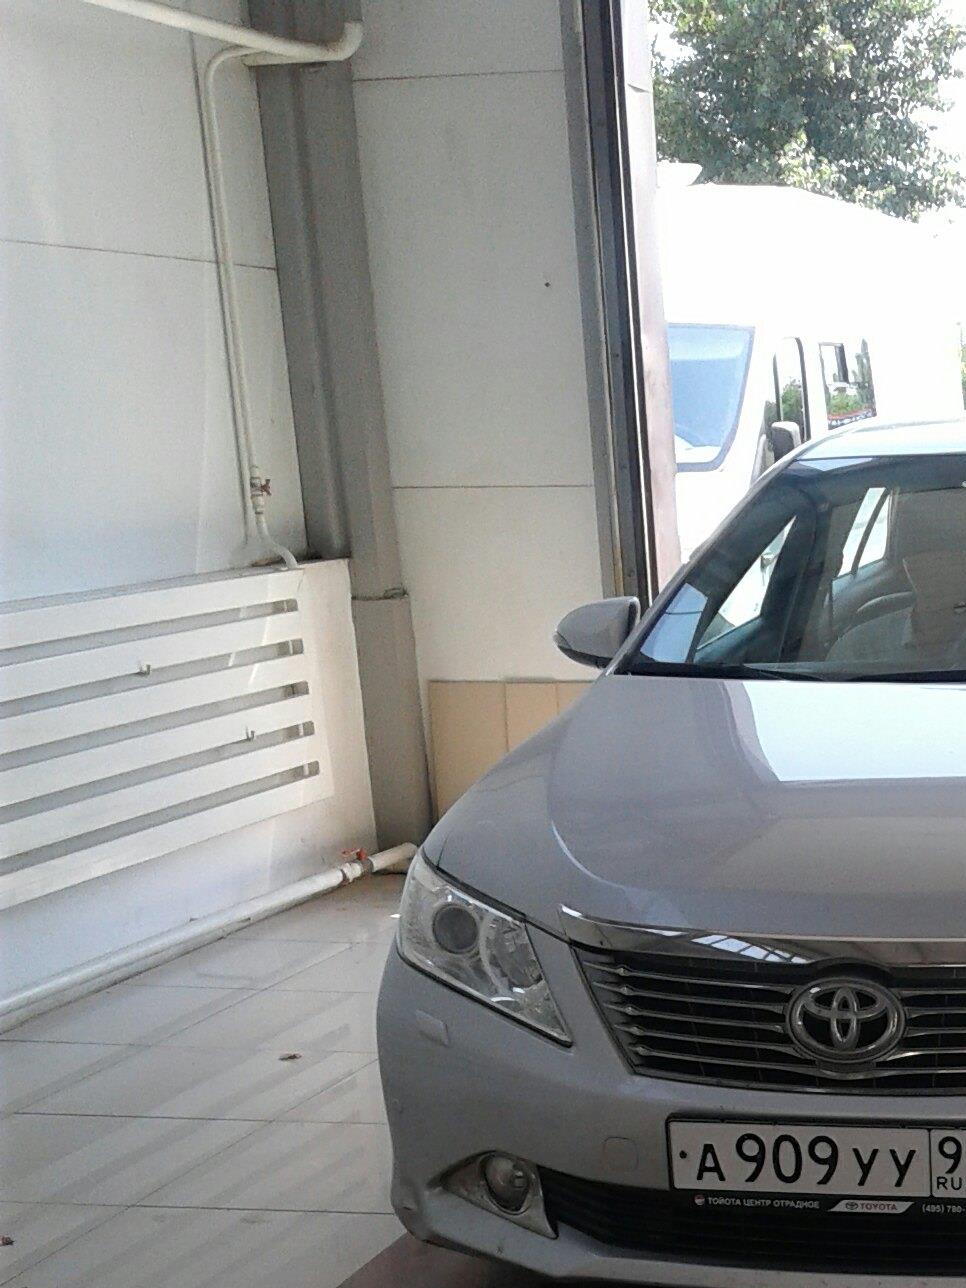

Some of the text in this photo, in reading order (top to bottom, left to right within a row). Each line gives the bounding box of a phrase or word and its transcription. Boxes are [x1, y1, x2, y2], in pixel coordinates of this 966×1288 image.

[708, 1196, 820, 1209] ТОЙОТА ЦЕНТР ОТРАДНОЕ
[860, 1202, 898, 1211] TOYOTA
